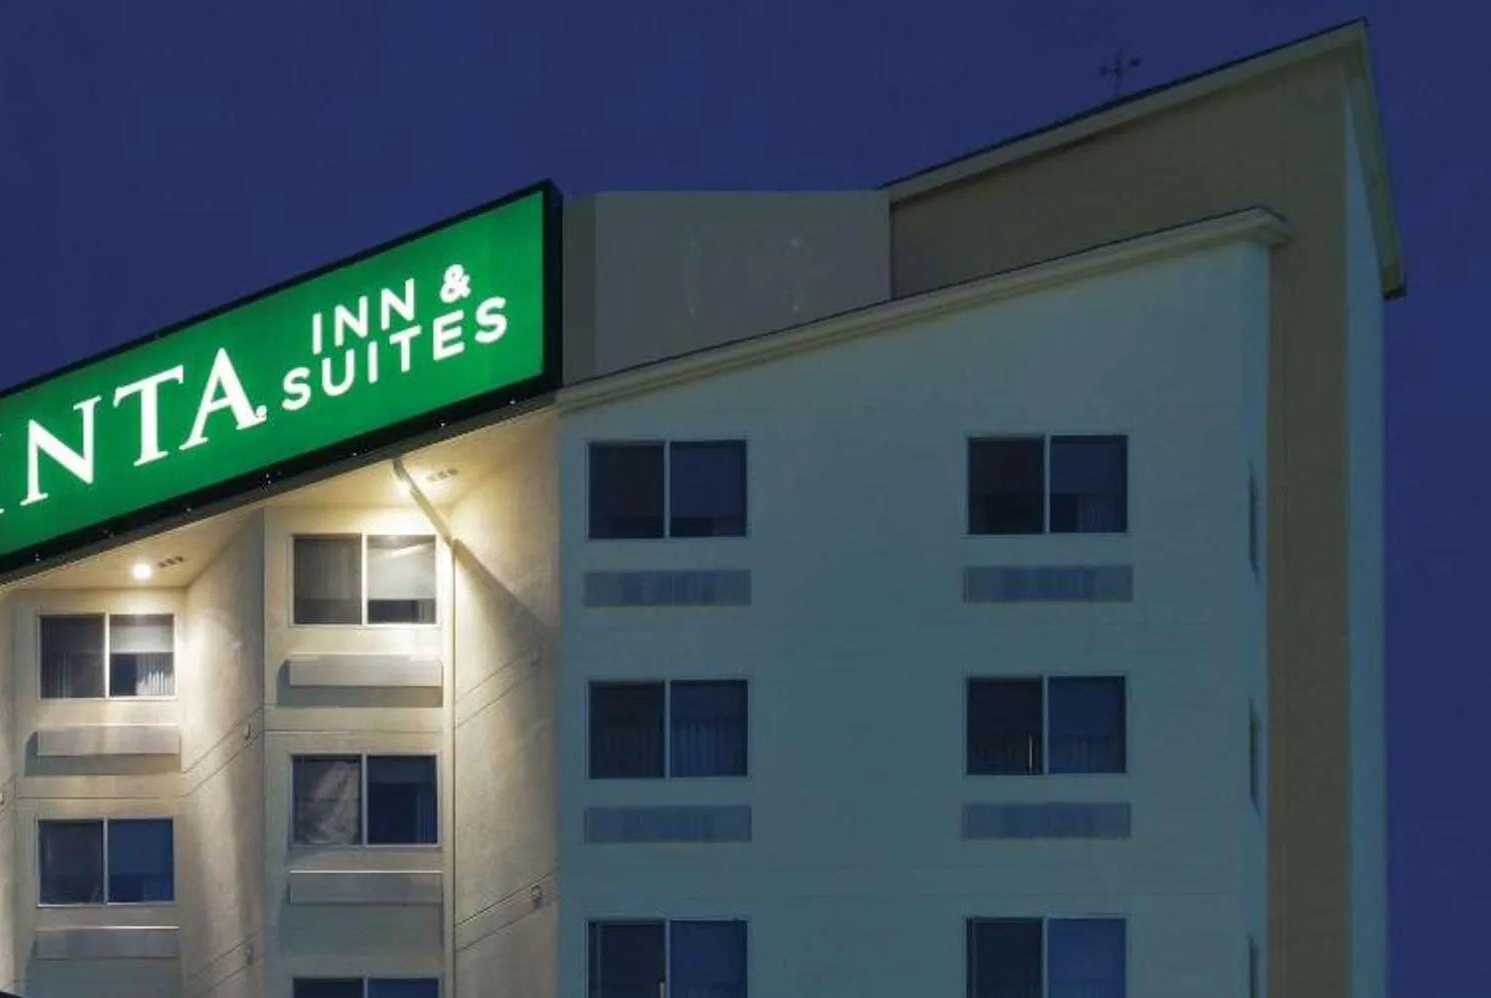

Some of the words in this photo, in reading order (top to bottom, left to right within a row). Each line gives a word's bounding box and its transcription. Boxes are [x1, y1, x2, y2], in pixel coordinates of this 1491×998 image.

[281, 296, 509, 412] SUITES
[312, 278, 416, 356] INN
[438, 262, 472, 305] &
